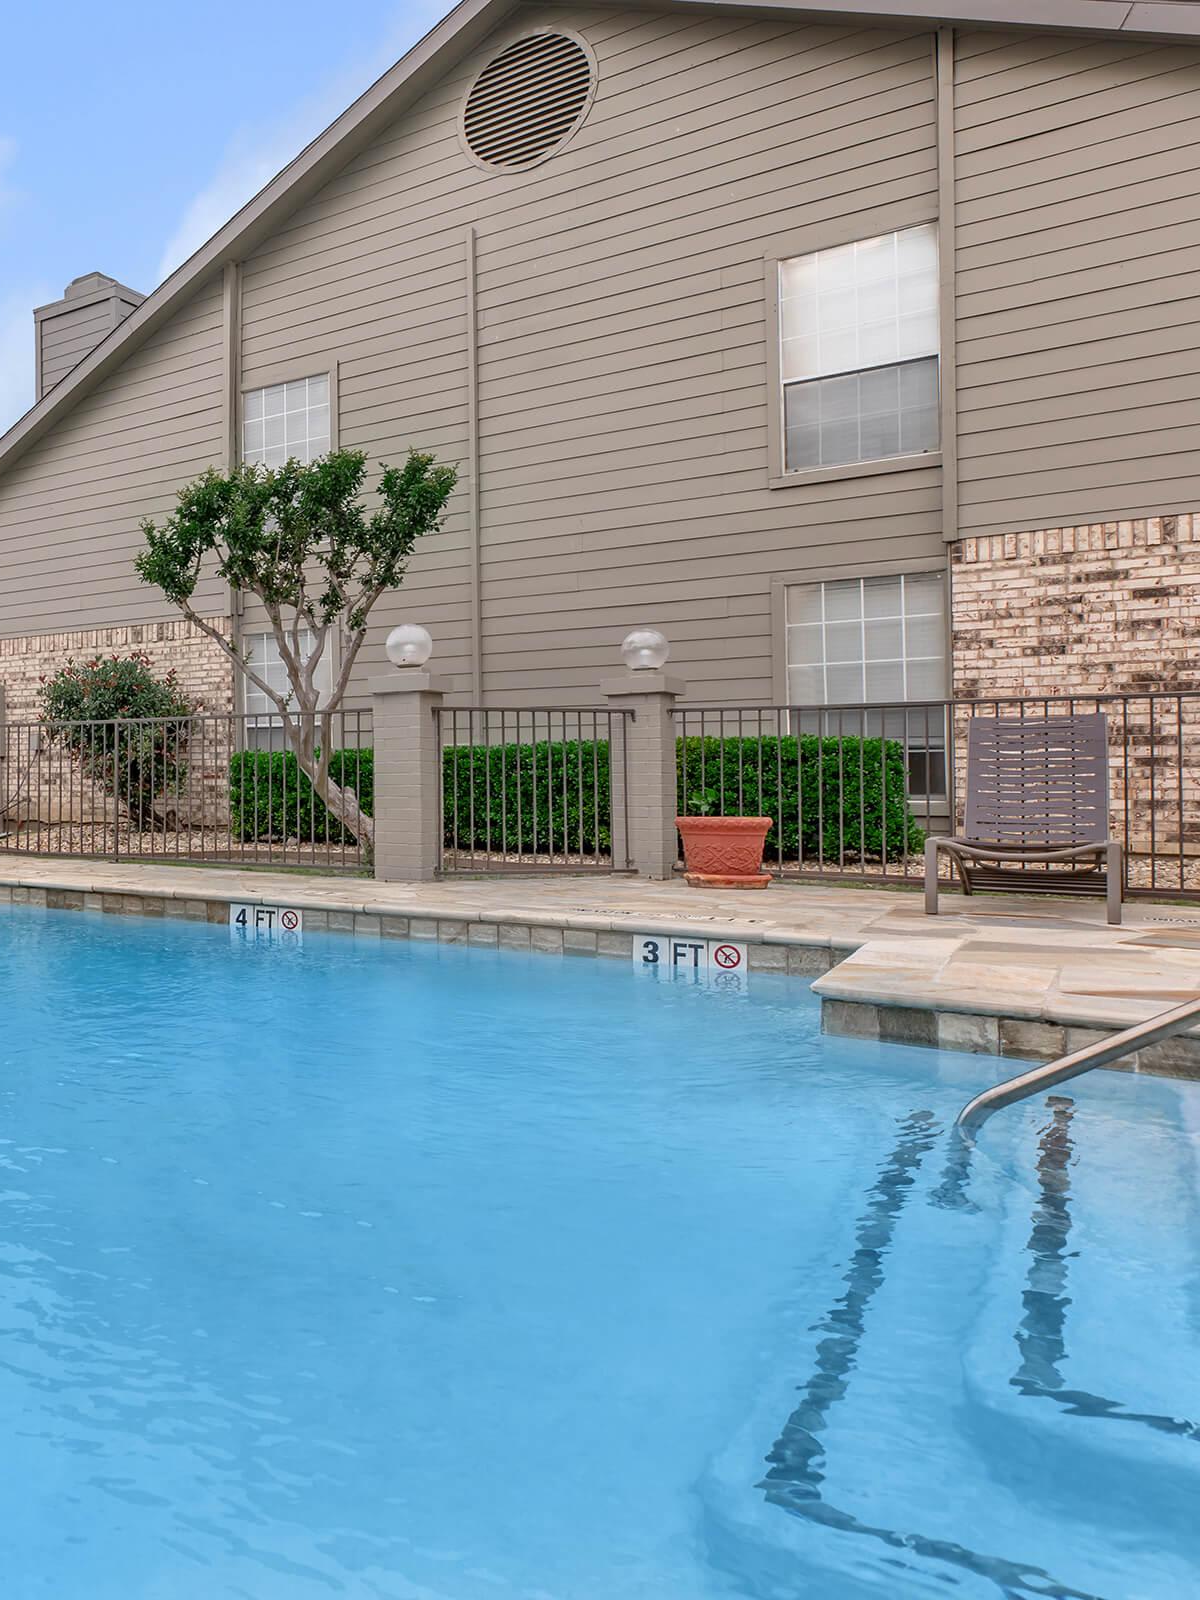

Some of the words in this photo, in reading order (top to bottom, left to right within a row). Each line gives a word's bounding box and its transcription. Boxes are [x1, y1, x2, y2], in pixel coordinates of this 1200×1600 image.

[235, 908, 247, 926] 4
[256, 910, 276, 928] FT
[642, 941, 659, 963] 3
[673, 943, 704, 967] FT
